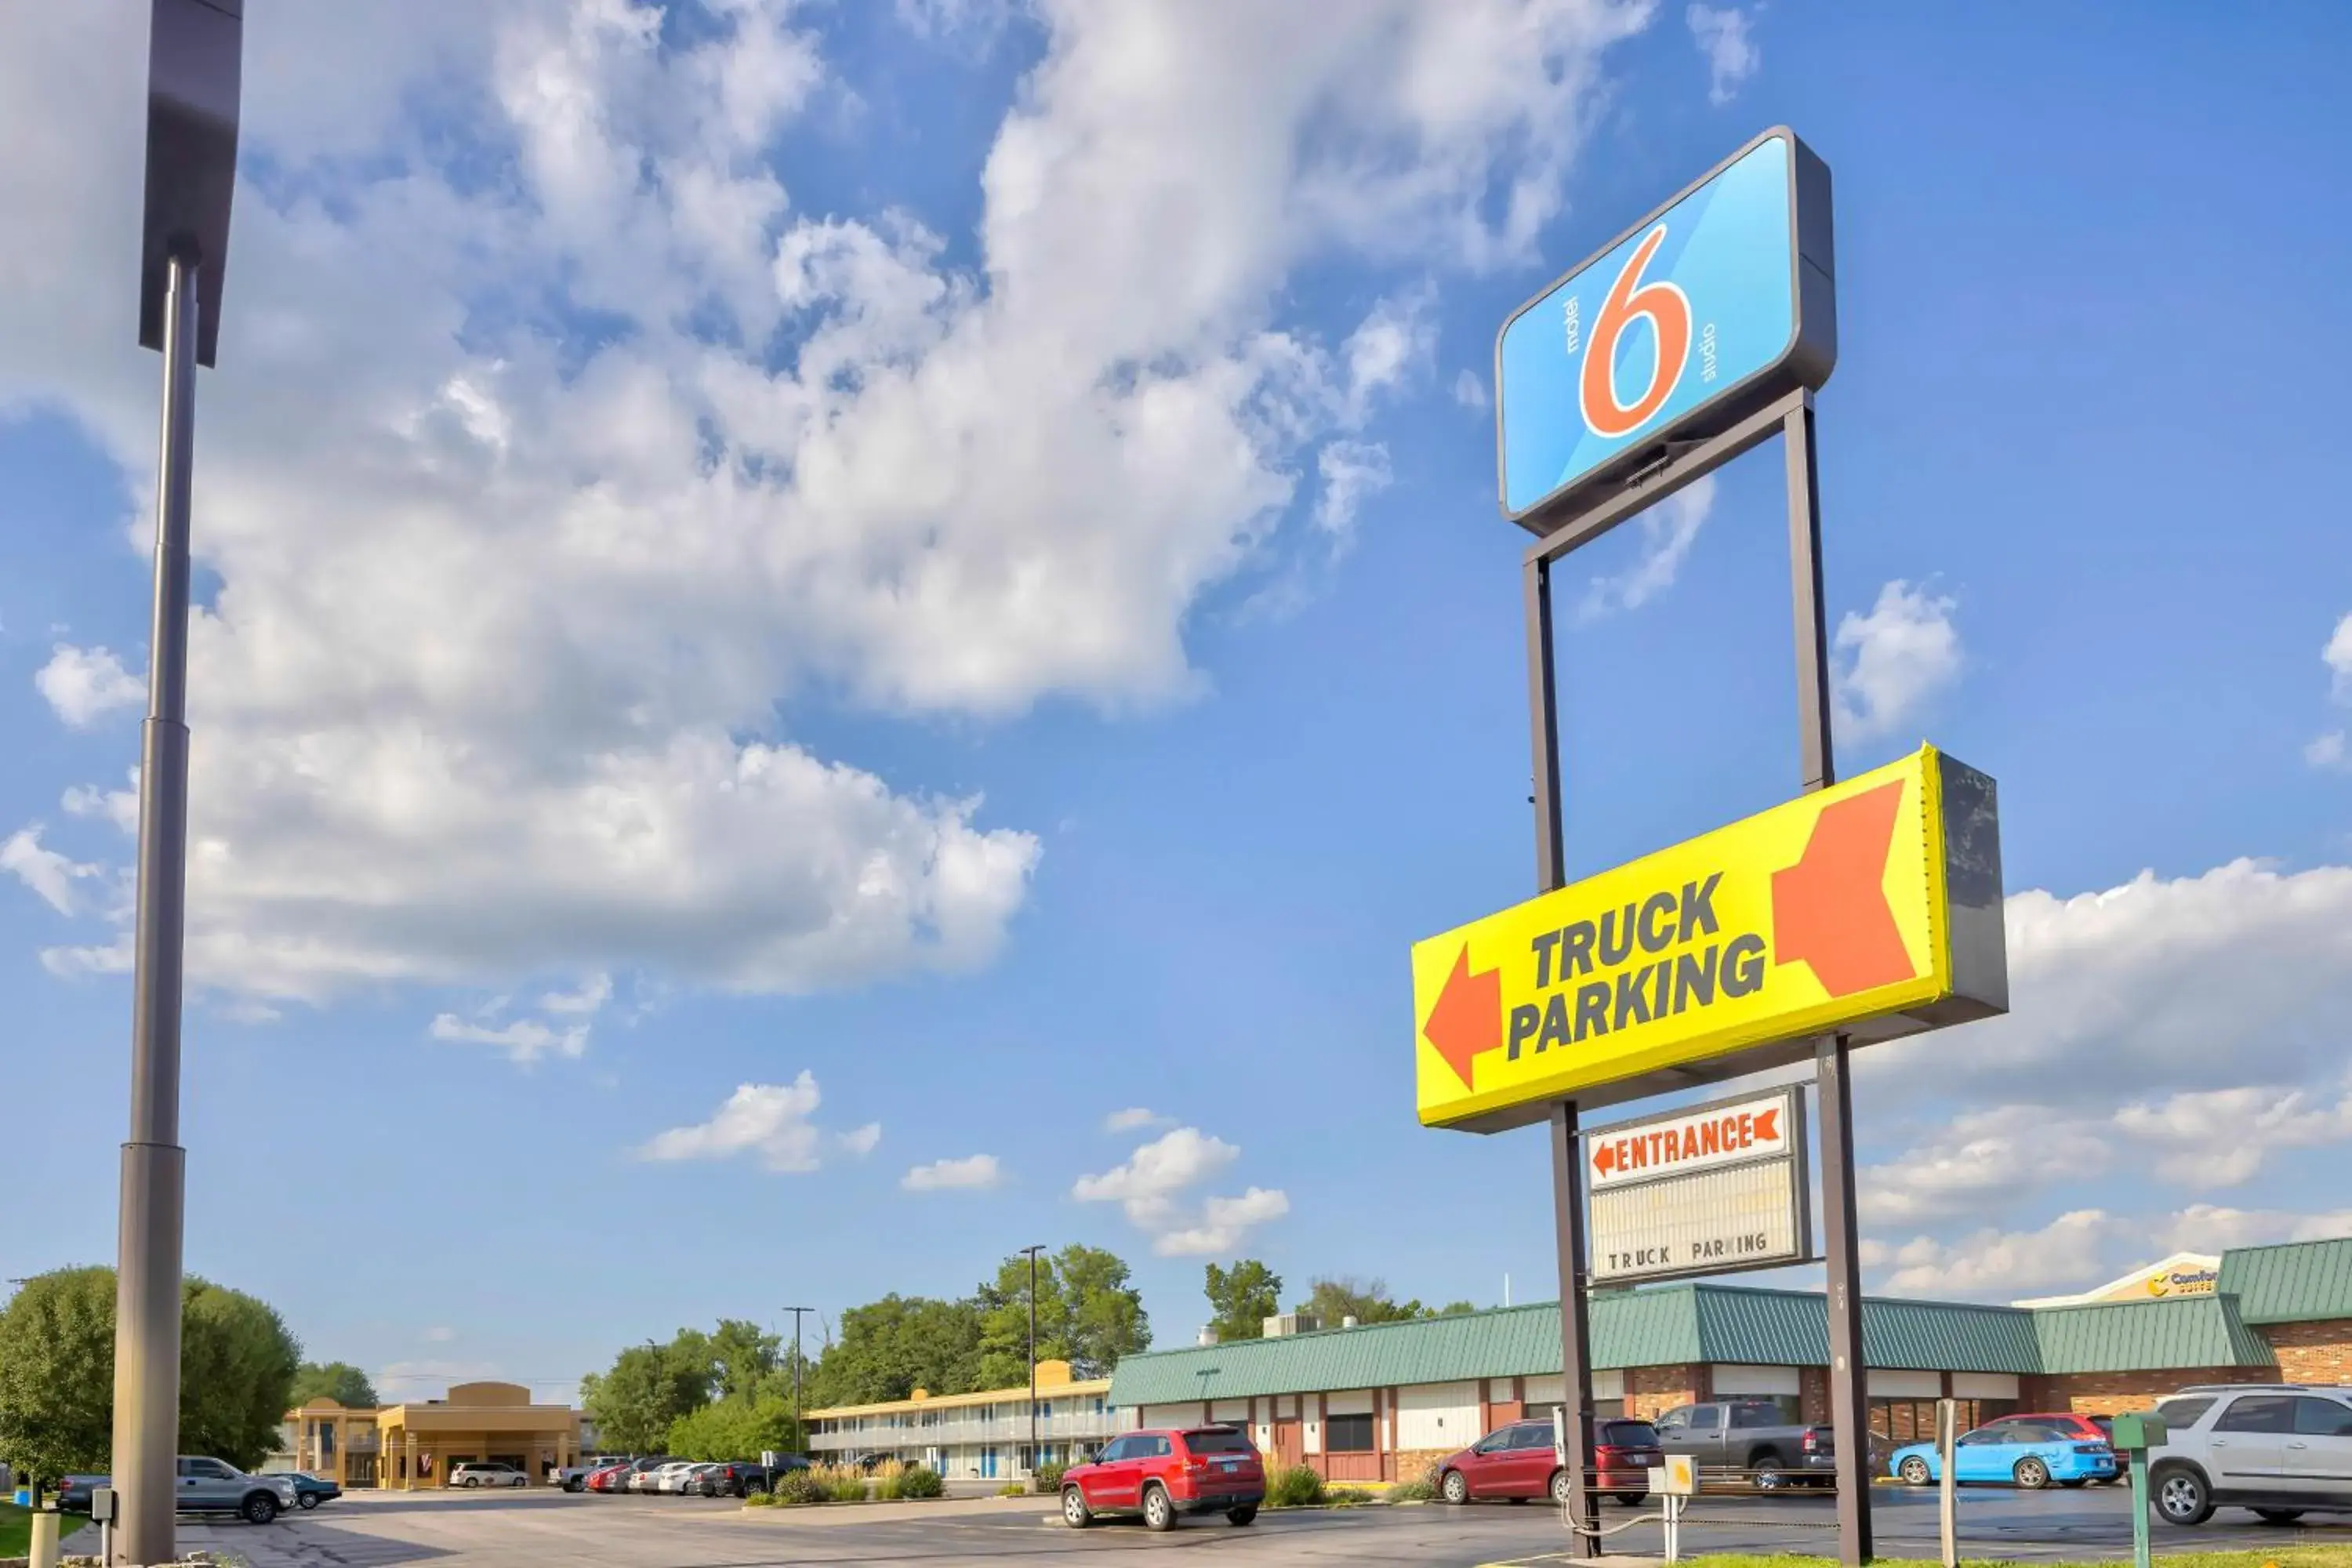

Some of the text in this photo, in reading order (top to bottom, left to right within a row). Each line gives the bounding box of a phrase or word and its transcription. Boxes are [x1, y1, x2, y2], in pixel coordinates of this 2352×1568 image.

[1563, 296, 1579, 354] motel
[1579, 223, 1692, 438] 6
[1698, 323, 1716, 383] studio
[1531, 871, 1724, 989] TRUCK
[1508, 934, 1766, 1062] PARKING
[1616, 1112, 1752, 1172] ENTRANCE
[1609, 1246, 1669, 1270] TRUCK
[2171, 1269, 2218, 1285] Comfor
